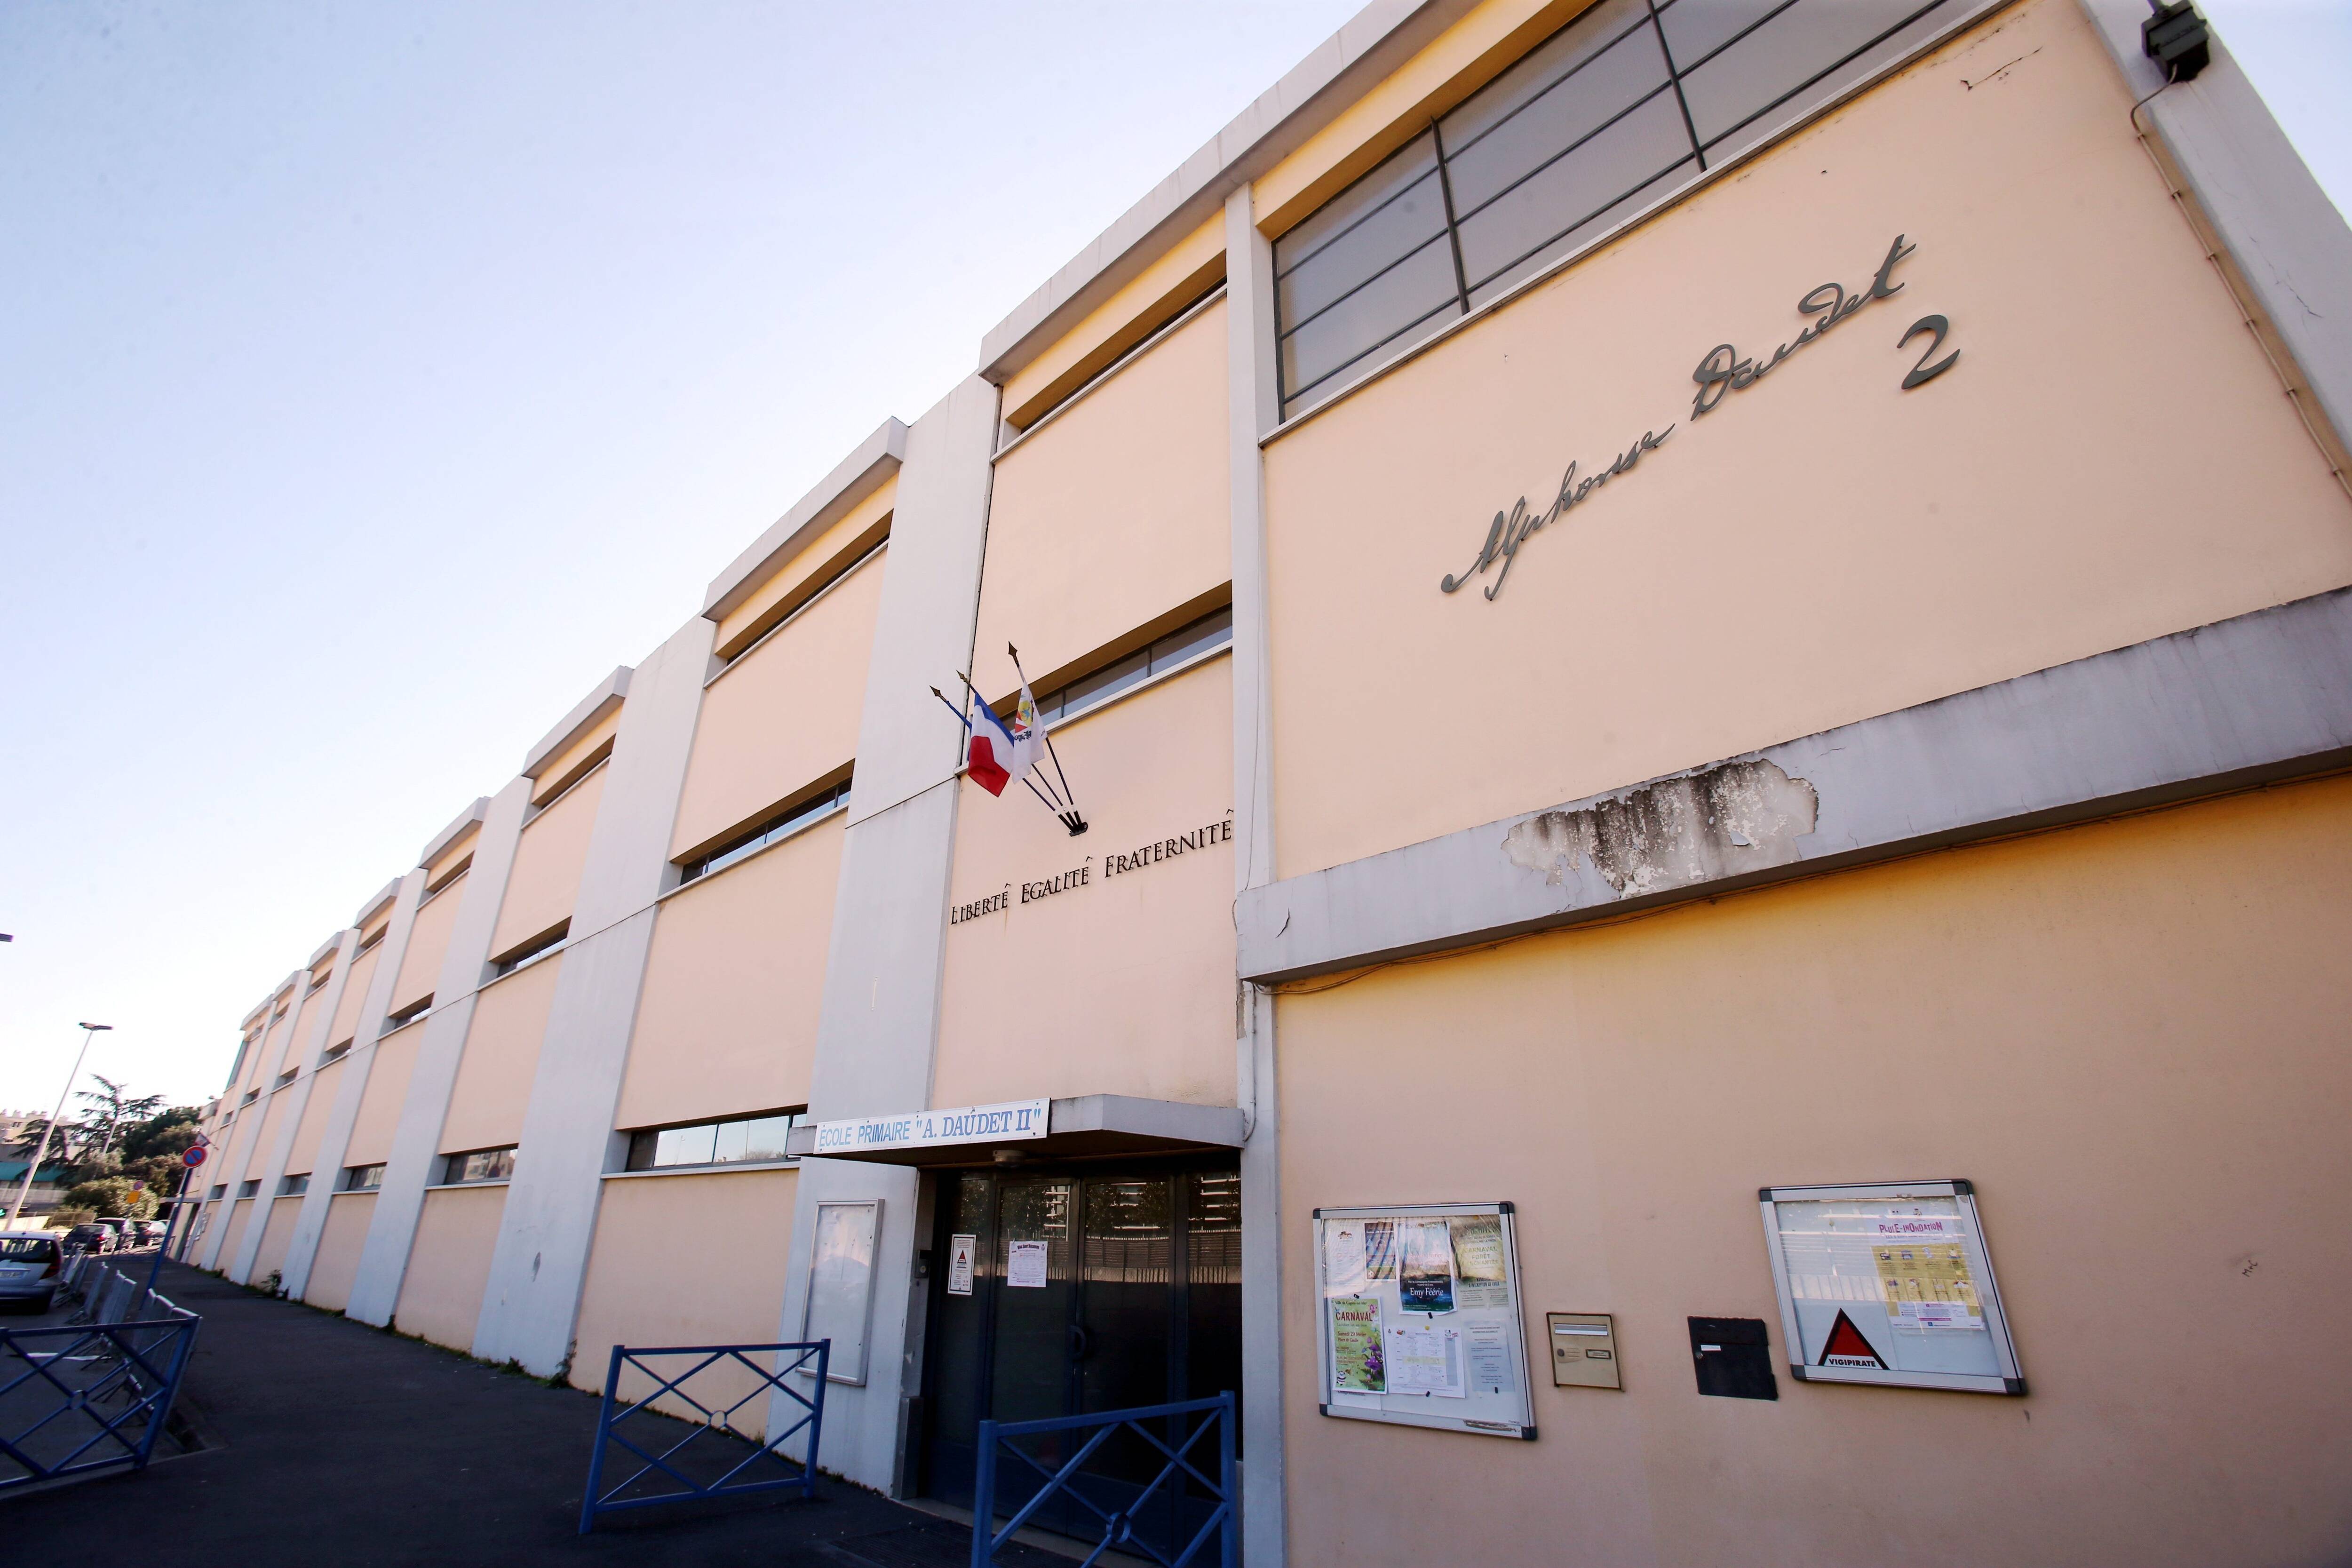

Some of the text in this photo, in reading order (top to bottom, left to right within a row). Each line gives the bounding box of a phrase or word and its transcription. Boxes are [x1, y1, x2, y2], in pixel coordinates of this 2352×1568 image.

[1897, 314, 1960, 390] 2
[1441, 234, 1916, 600] Alphonse Daudet
[858, 1121, 911, 1144] PRIMAIRE
[941, 1111, 1012, 1137] DAUDET
[1410, 1287, 1444, 1298] Emy Féérie
[1336, 1311, 1373, 1321] CARNAVAL
[1828, 1358, 1876, 1367] VIGIPIRATE
